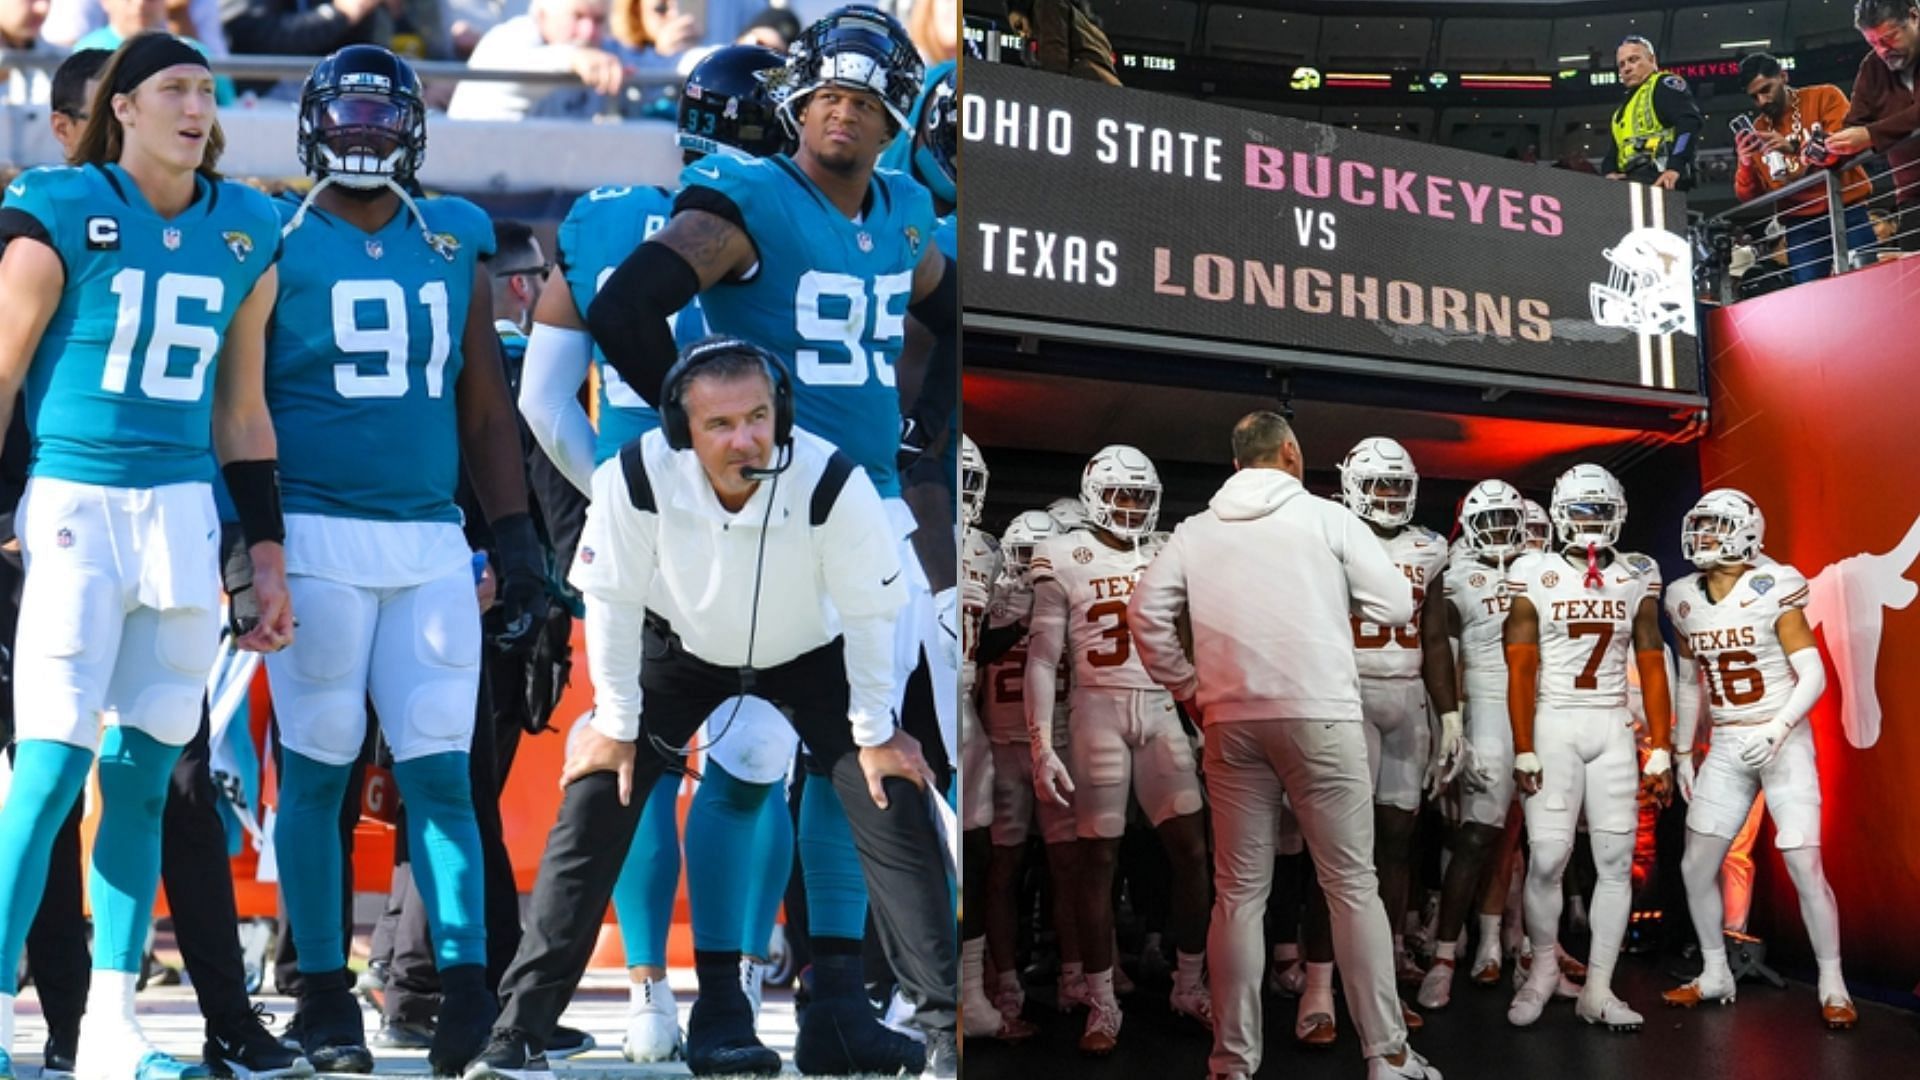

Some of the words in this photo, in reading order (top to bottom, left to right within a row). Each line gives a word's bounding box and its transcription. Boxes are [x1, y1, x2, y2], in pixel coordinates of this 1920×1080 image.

[1123, 55, 1136, 67] VS
[1143, 56, 1176, 71] TEXAS
[686, 108, 717, 135] 93
[963, 93, 1072, 156] OHIO
[1096, 118, 1222, 182] STATE
[1244, 142, 1563, 237] BUCKEYES
[88, 217, 118, 243] C
[1294, 206, 1337, 250] VS
[978, 222, 1119, 288] TEXAS
[1154, 246, 1552, 342] LONGHORNS
[101, 267, 224, 401] 16
[331, 279, 450, 399] 91
[795, 270, 914, 387] 95
[1086, 600, 1130, 668] 3
[1551, 600, 1626, 621] TEXAS
[1567, 622, 1615, 690] 7
[1690, 626, 1756, 652] TEXAS
[1697, 650, 1765, 706] 16
[367, 776, 385, 812] G
